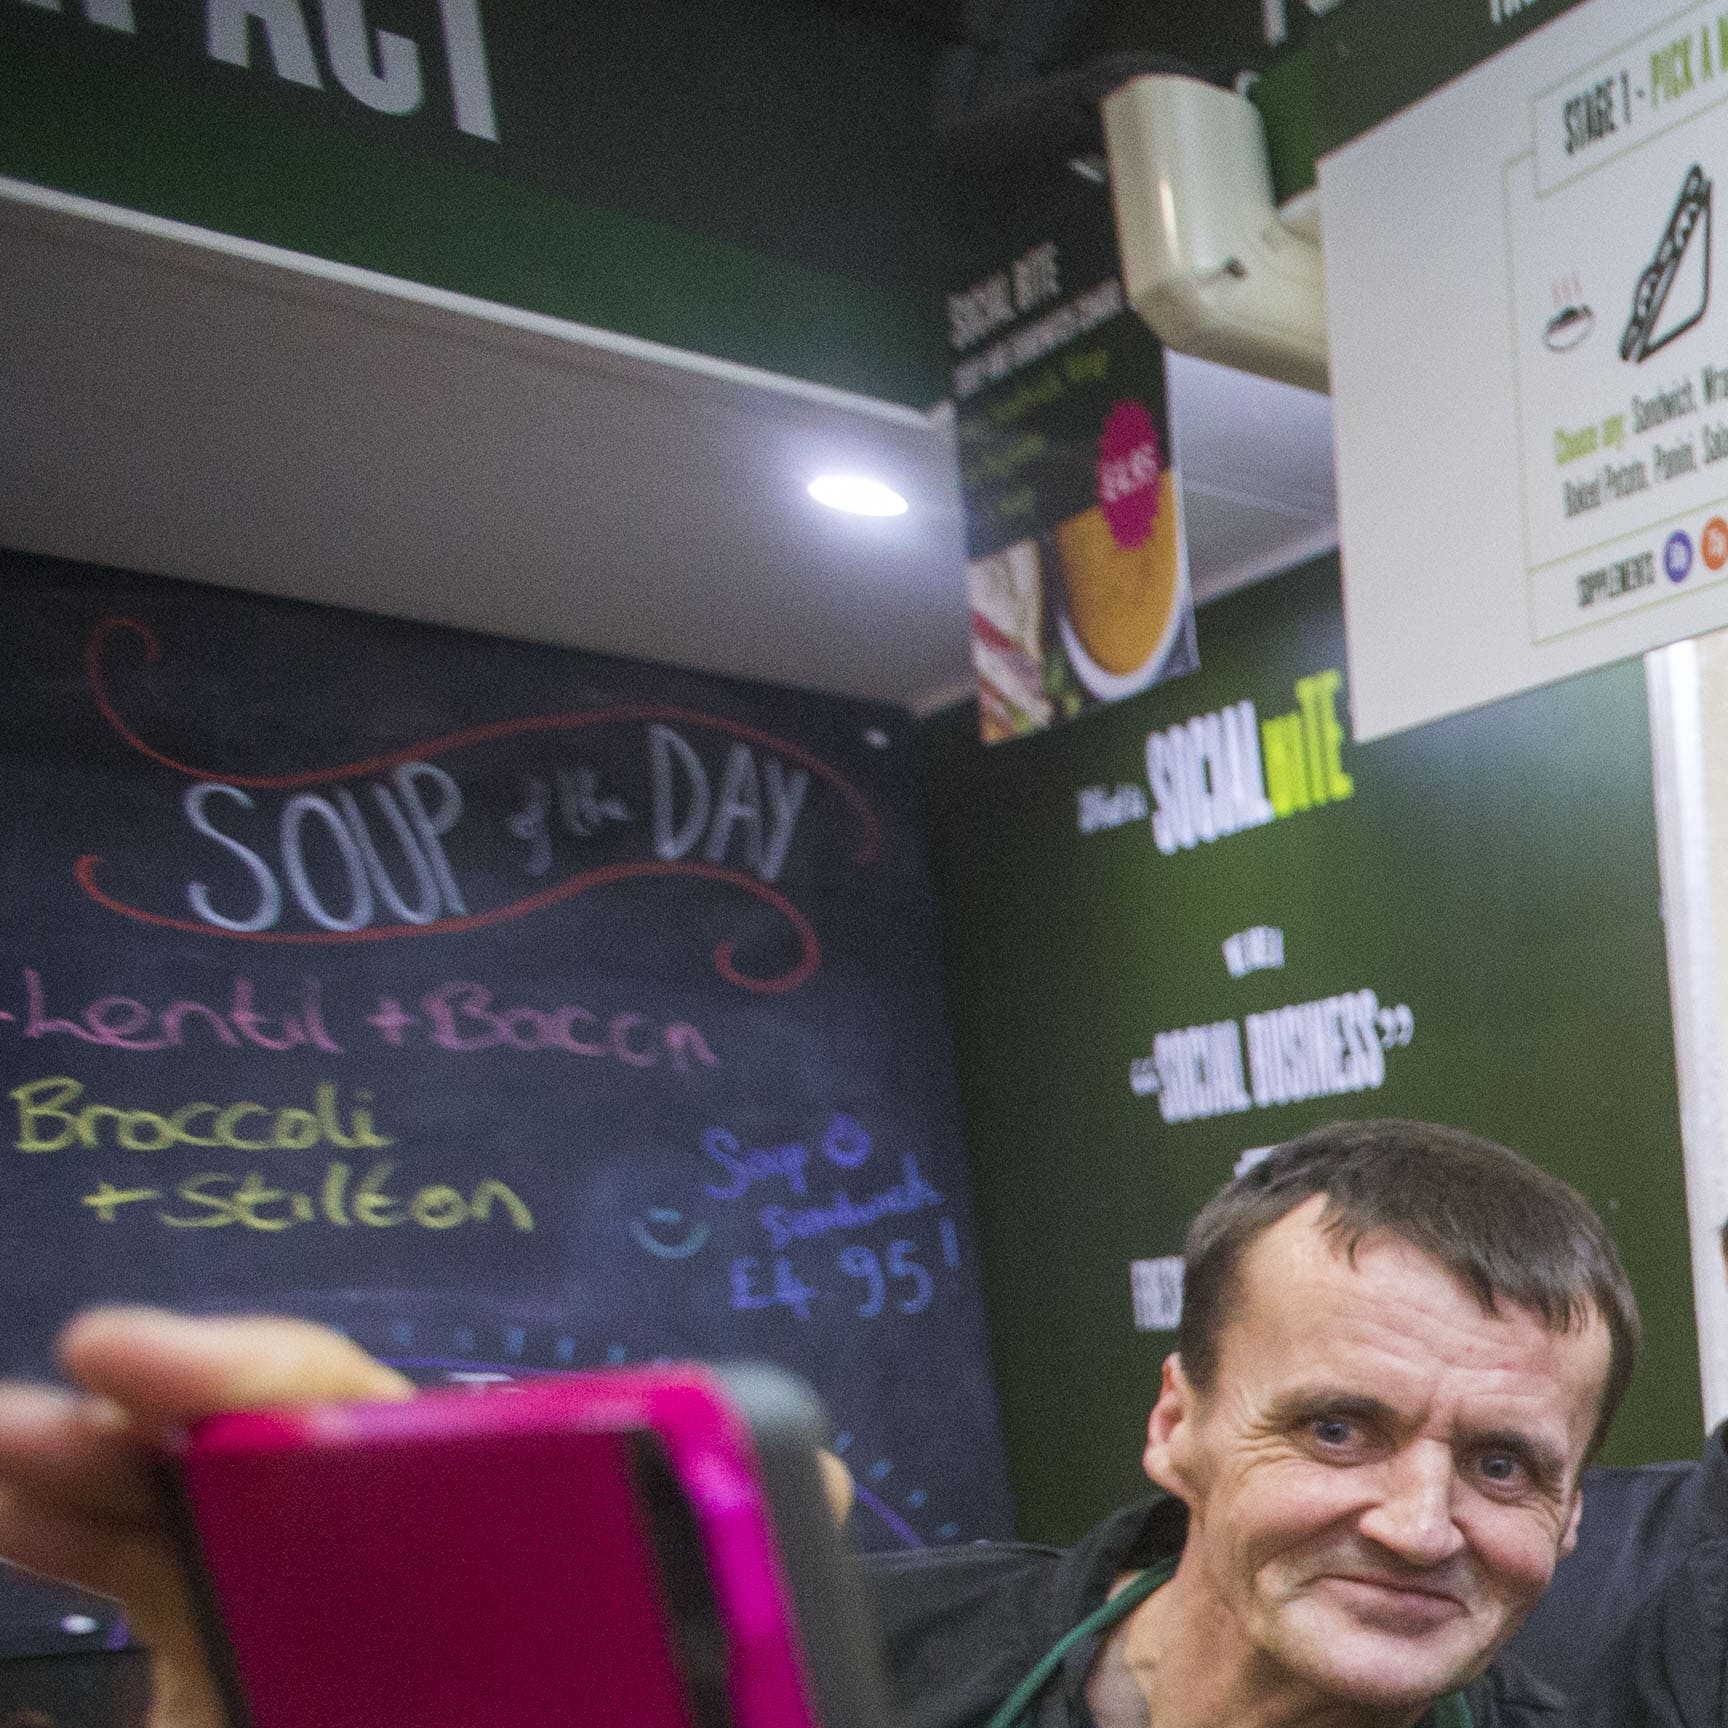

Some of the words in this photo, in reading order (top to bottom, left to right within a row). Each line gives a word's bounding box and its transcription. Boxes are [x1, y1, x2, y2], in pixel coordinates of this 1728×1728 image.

[1563, 75, 1616, 155] STAGE
[1650, 34, 1695, 111] PICK
[1701, 25, 1713, 81] A
[184, 761, 468, 932] SOUP
[649, 724, 811, 883] DAY
[1145, 699, 1275, 856] SOCIAL
[26, 967, 345, 1054] Lentil
[11, 1076, 393, 1153] Broccoli
[162, 1165, 537, 1232] Stilton
